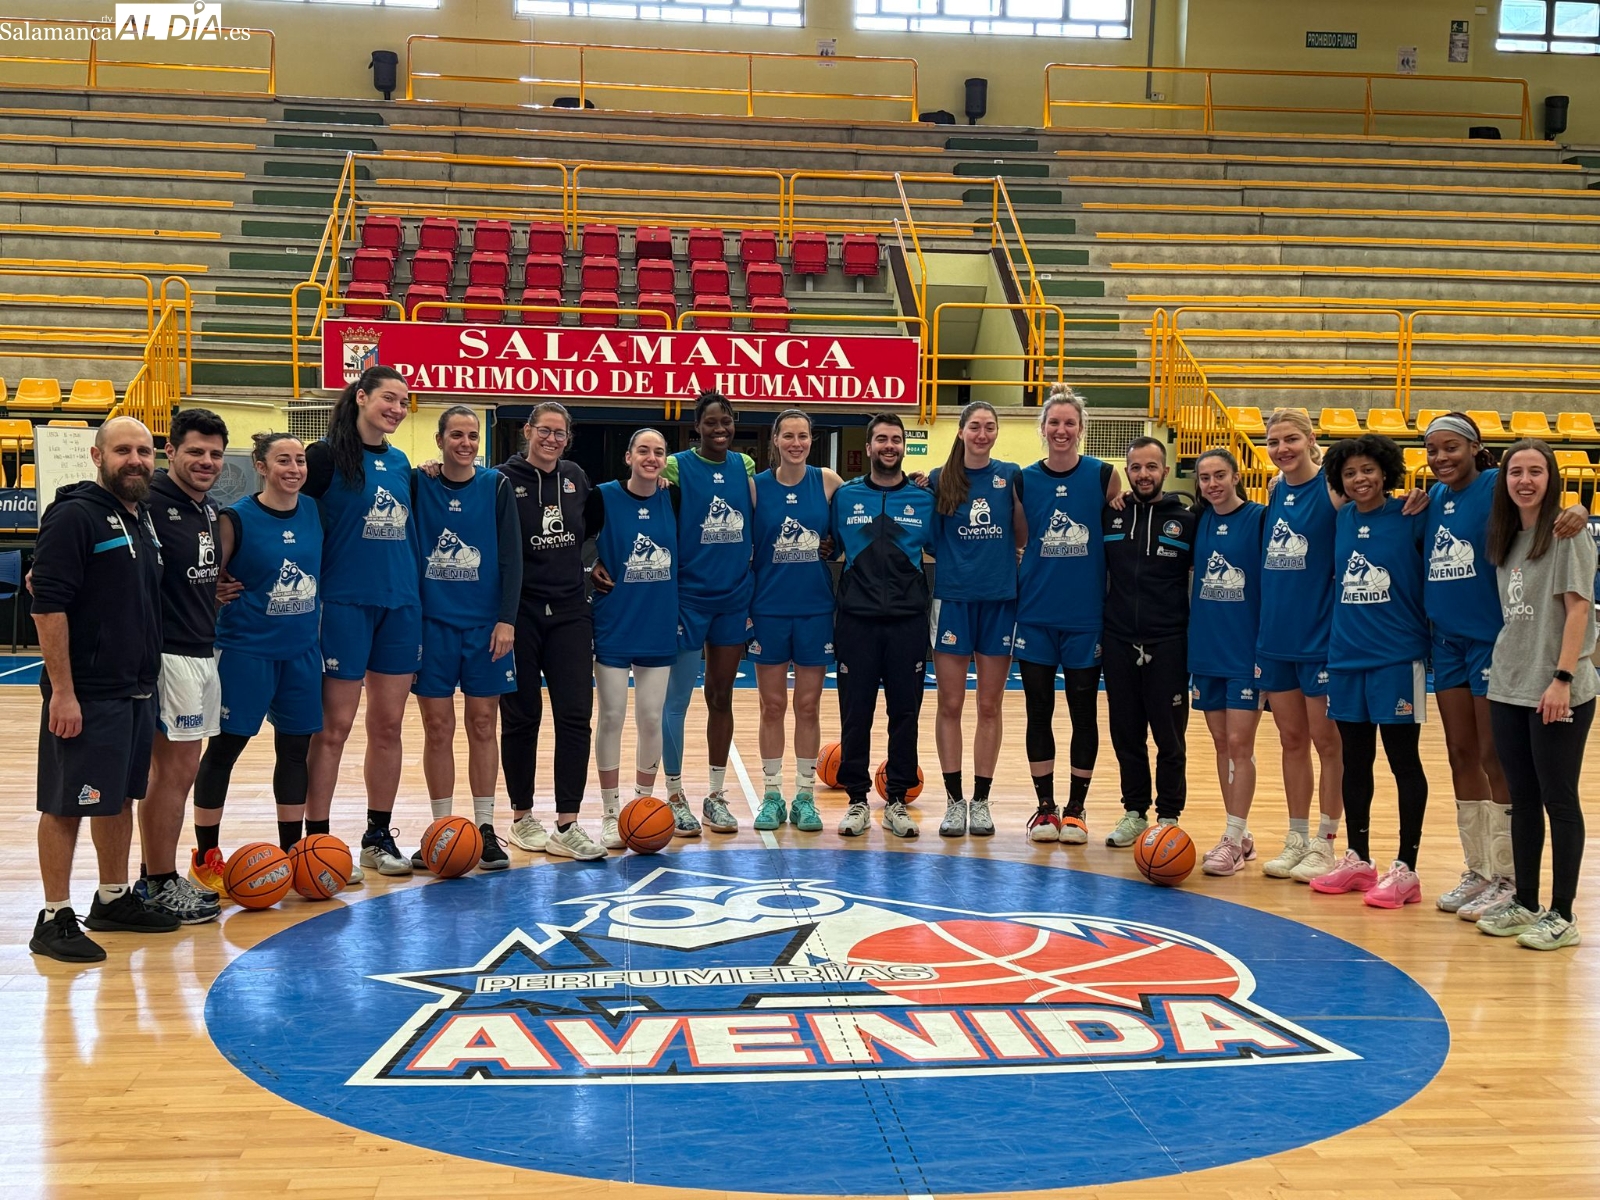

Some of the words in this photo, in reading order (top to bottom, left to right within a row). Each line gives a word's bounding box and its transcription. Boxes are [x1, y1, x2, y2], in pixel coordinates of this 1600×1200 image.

[1307, 33, 1337, 47] PROHIBIDO
[1337, 34, 1356, 48] FUMAR
[459, 328, 855, 369] SALAMANCA
[393, 363, 600, 393] PATRIMONIO
[609, 369, 654, 394] DE
[664, 371, 702, 395] LA
[713, 372, 906, 399] HUMANIDAD
[904, 430, 926, 439] SALIDA
[846, 515, 873, 526] AVENIDA
[958, 523, 1003, 536] avenida
[428, 567, 477, 579] AVENIDA
[1430, 564, 1474, 579] AVENIDA
[406, 1000, 1300, 1070] AVENIDA
